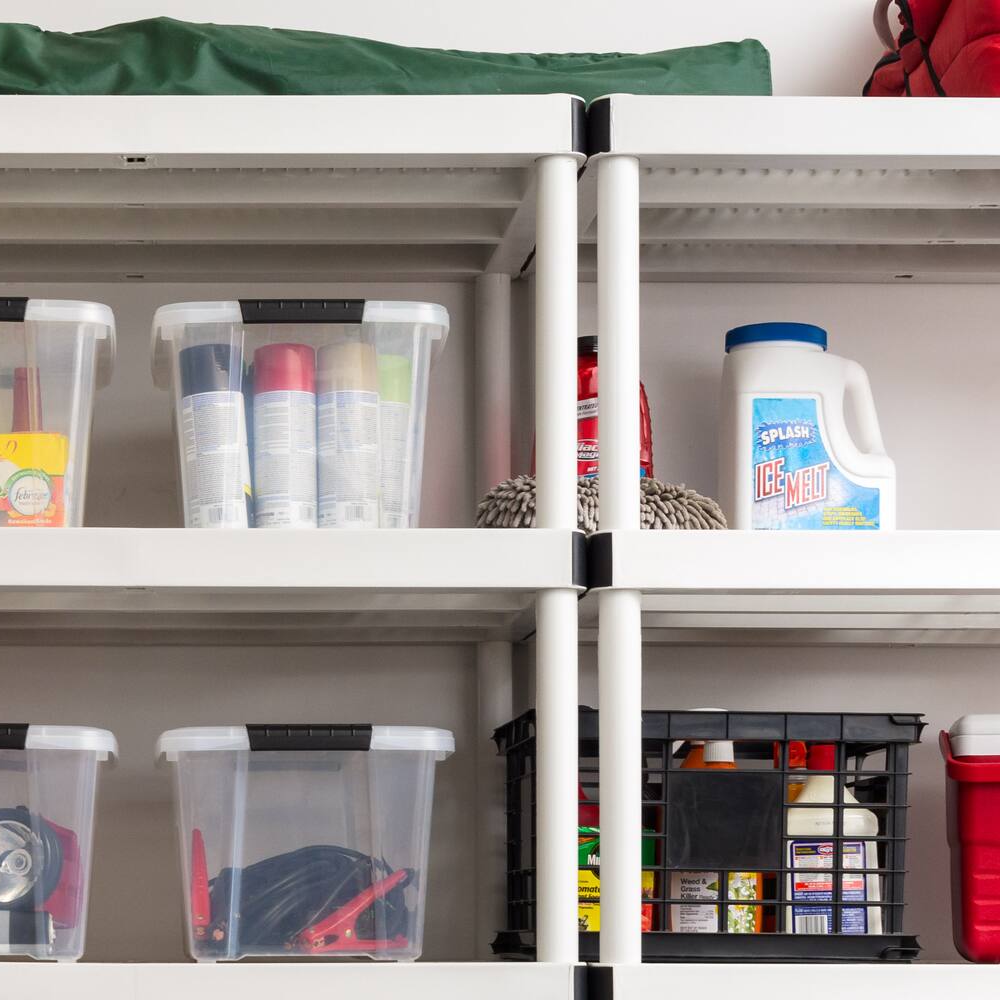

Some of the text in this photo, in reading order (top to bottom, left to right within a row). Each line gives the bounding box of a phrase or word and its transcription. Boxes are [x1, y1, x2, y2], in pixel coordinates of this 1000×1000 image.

[761, 426, 810, 446] SPLASH
[755, 458, 830, 509] ICE MELT
